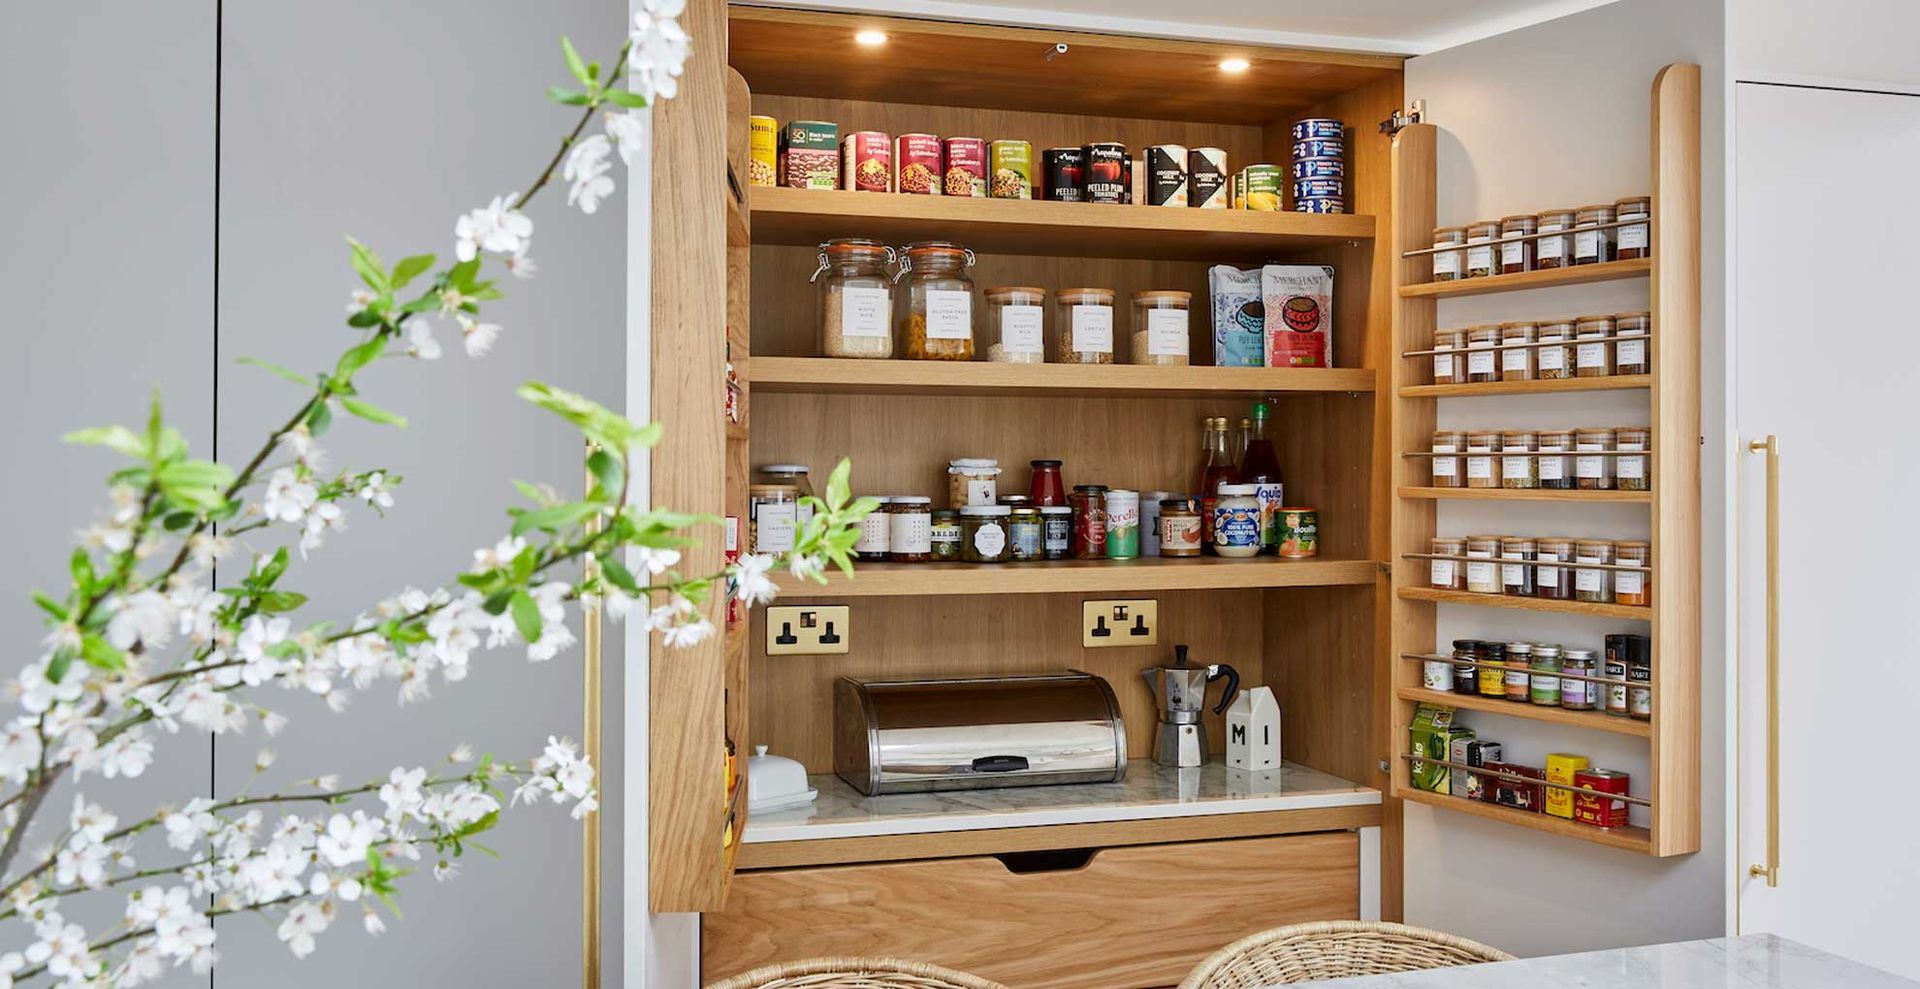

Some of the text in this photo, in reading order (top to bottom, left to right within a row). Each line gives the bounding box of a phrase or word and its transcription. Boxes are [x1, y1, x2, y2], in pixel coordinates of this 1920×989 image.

[1087, 183, 1109, 192] PEELED
[1232, 723, 1246, 746] M
[1264, 725, 1269, 745] I
